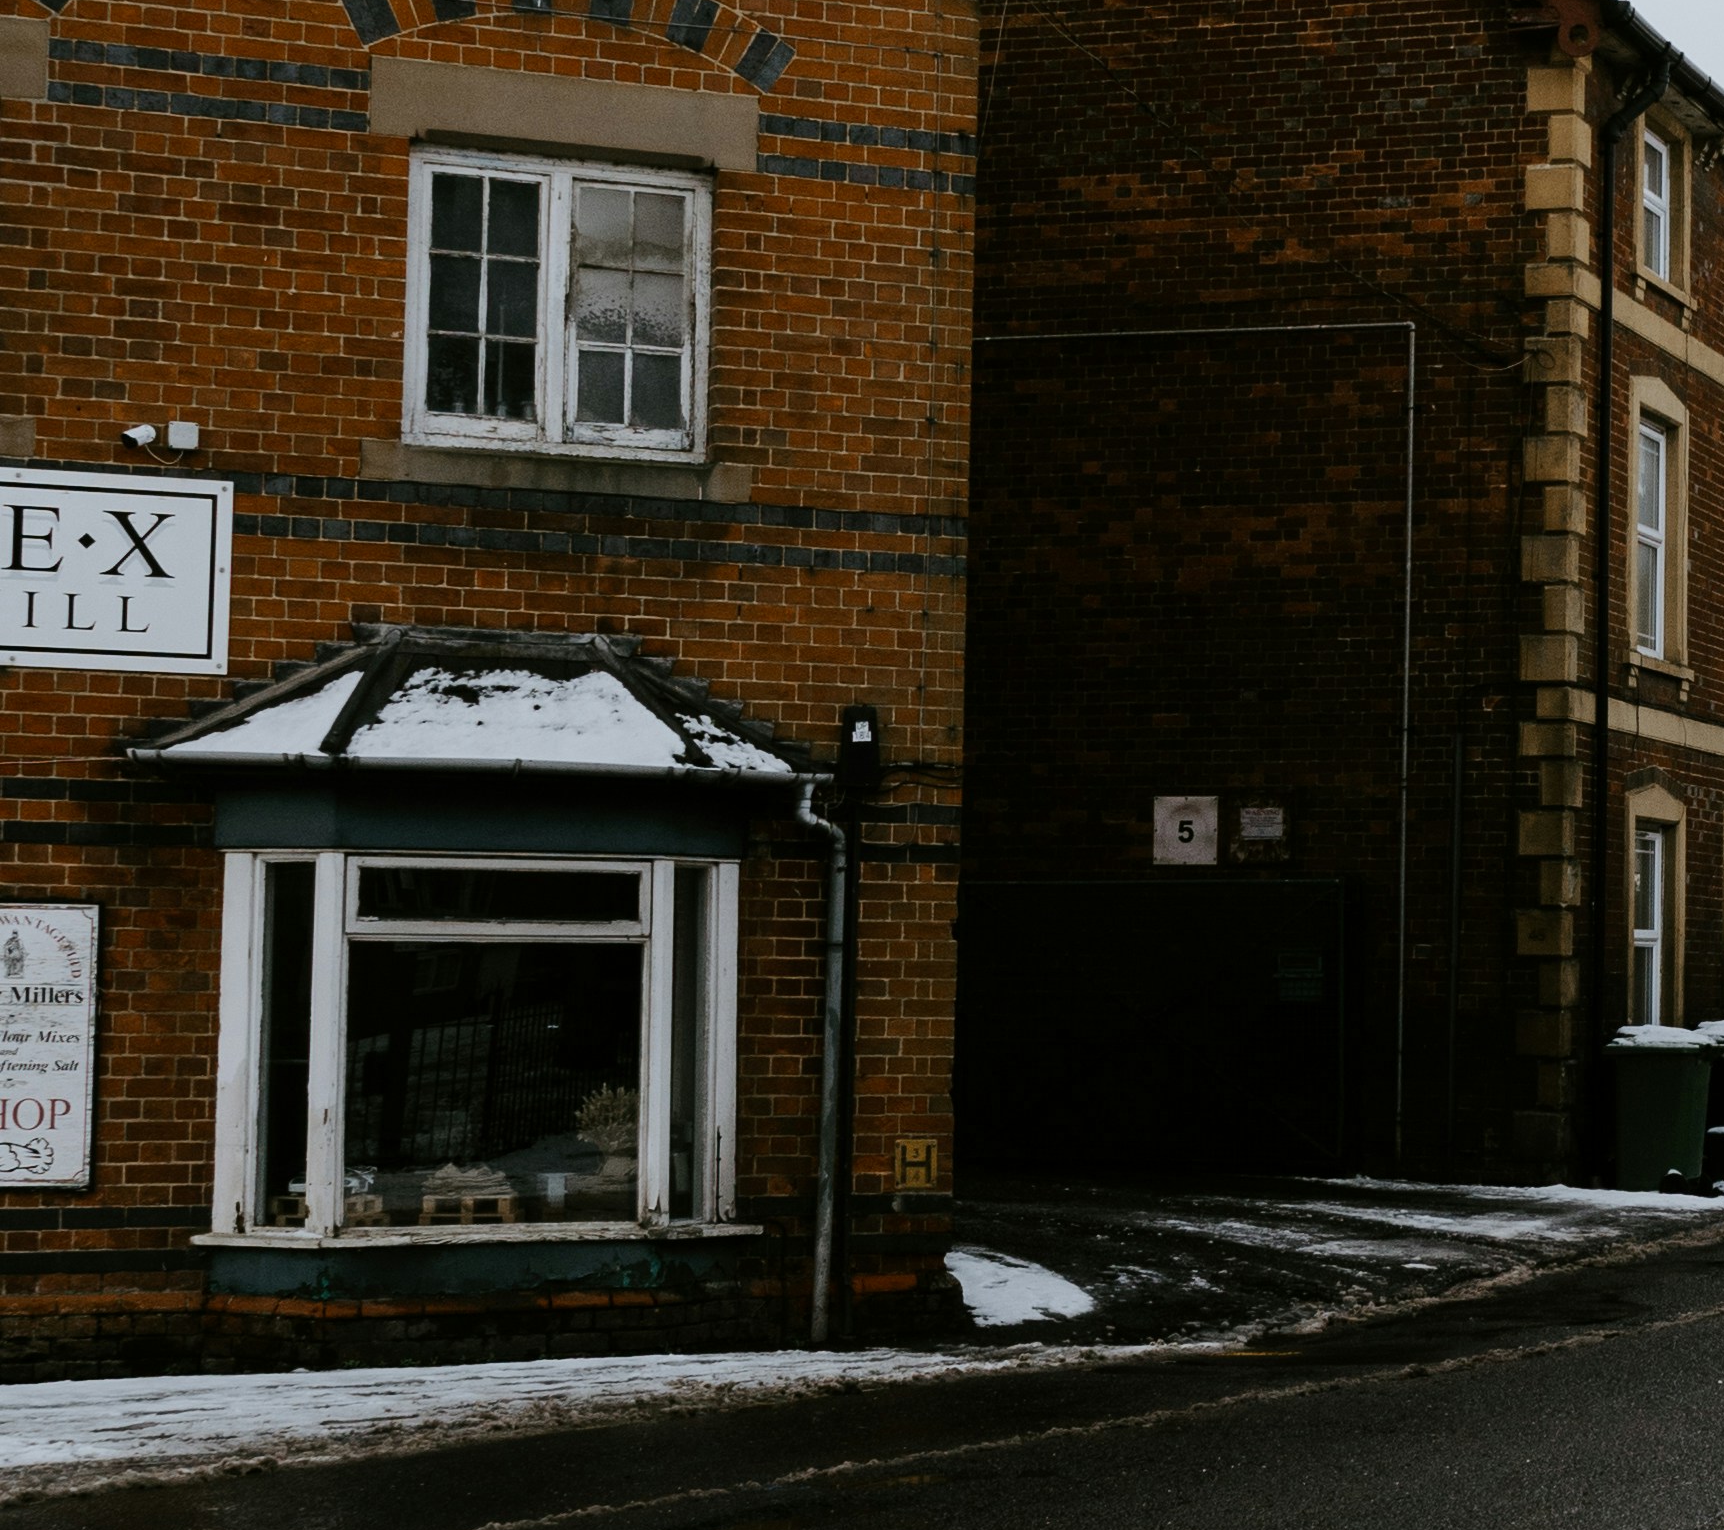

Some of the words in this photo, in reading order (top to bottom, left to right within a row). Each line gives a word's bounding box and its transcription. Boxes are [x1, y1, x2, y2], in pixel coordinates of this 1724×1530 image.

[1178, 820, 1194, 843] 5
[9, 986, 84, 1004] Millers
[0, 1030, 32, 1044] lour
[36, 1031, 80, 1043] Mixes
[52, 1059, 80, 1071] Salt
[901, 1144, 932, 1184] H
